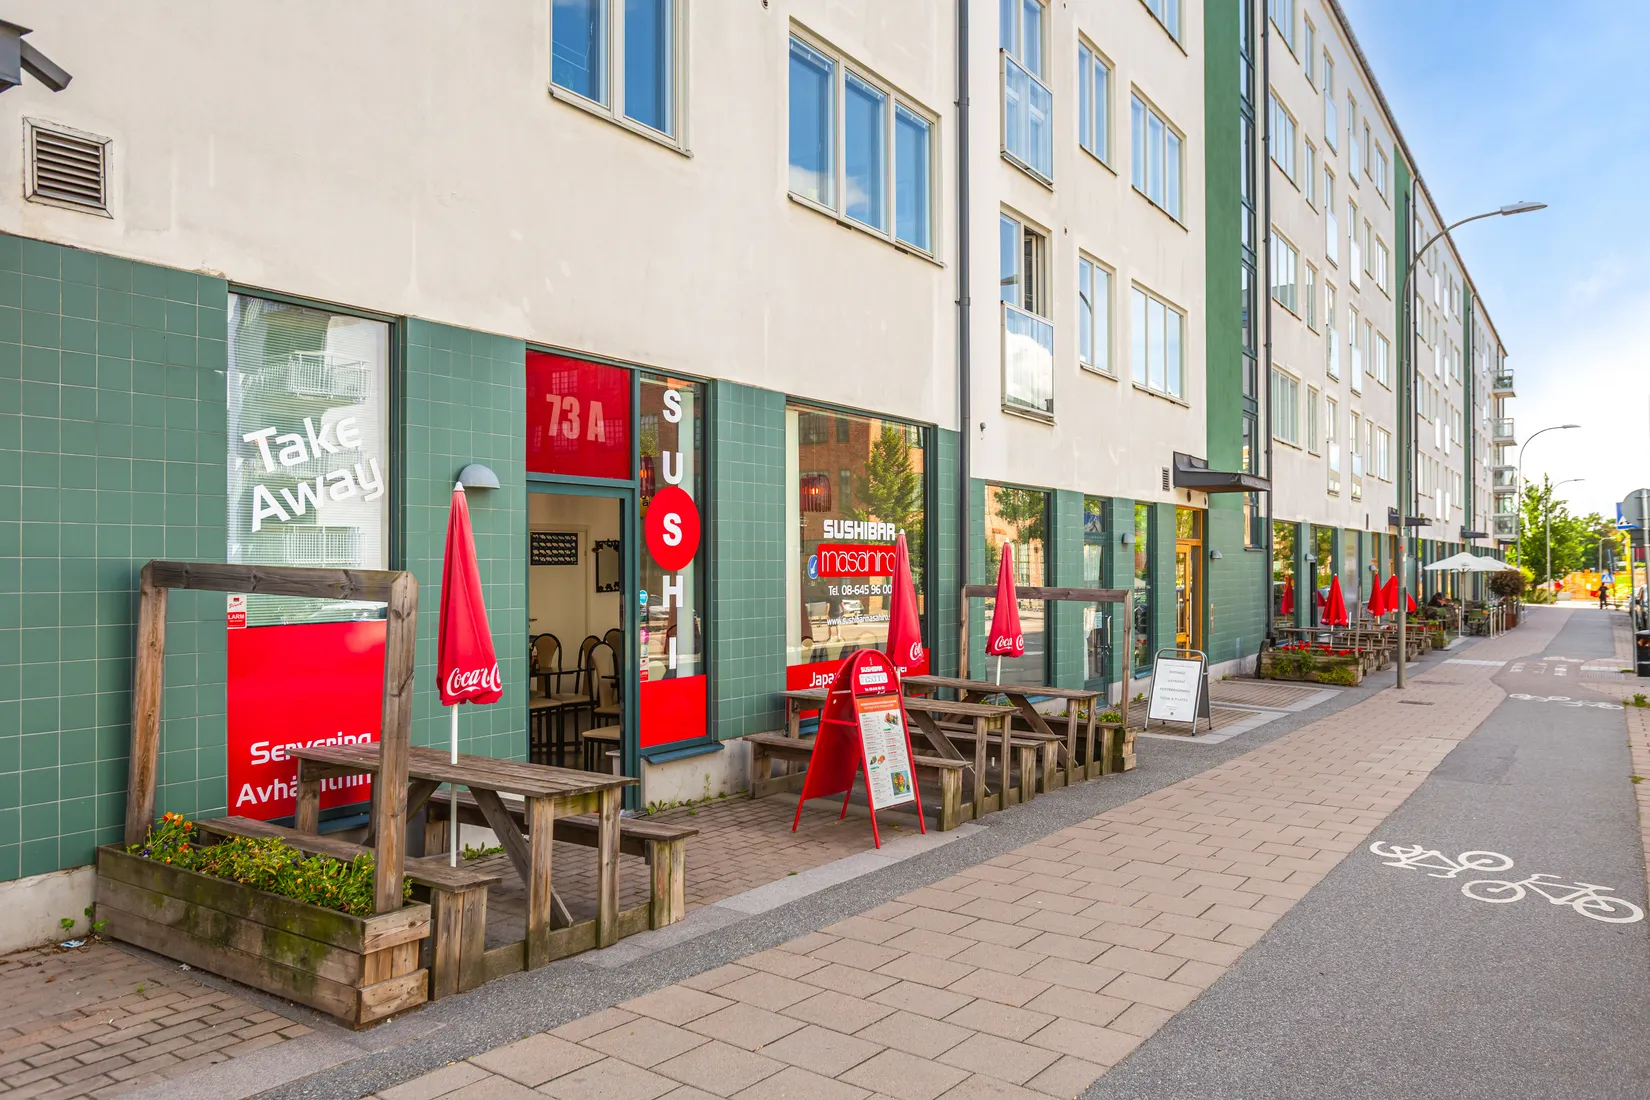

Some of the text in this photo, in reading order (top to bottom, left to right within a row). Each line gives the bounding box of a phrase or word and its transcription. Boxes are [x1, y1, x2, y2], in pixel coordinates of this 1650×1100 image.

[546, 394, 606, 443] 73 A
[242, 416, 363, 474] Take
[251, 457, 385, 533] Away
[662, 389, 684, 670] SUSHI
[823, 519, 896, 541] SUSHIBAR
[828, 585, 892, 596] Tel. 08-645 96 00
[827, 614, 890, 626] www.sushibarmasahiro.
[809, 671, 835, 688] Japa
